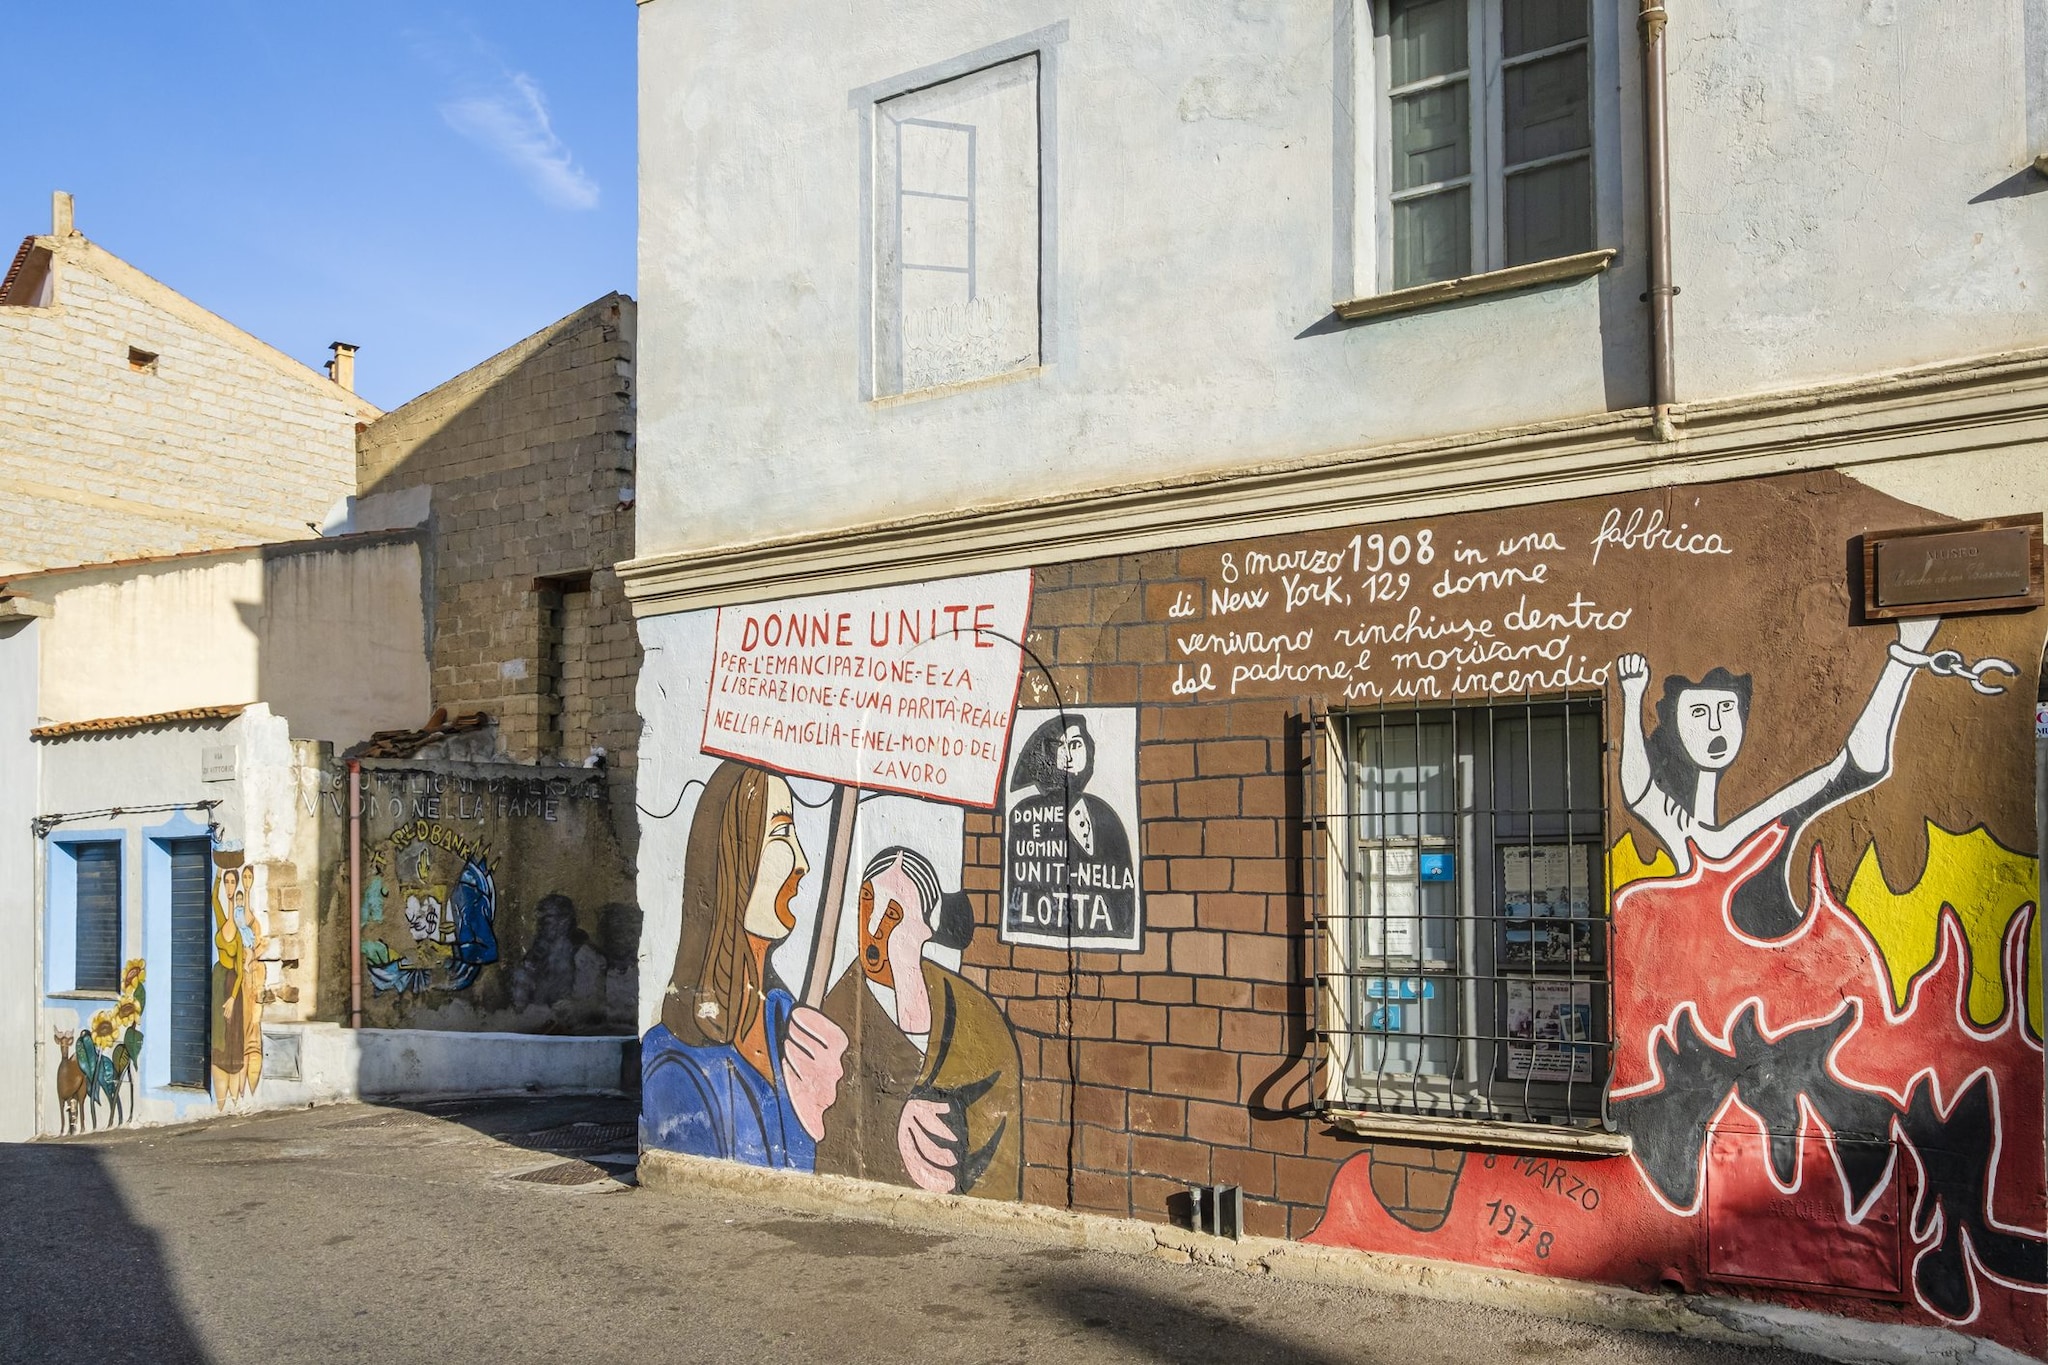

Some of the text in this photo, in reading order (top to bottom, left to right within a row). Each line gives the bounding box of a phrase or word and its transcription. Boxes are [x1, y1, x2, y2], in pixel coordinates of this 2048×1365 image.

[1220, 507, 1733, 583] 8 marzo 1908 in una fabbrica
[1168, 590, 1196, 618] di
[1211, 587, 1270, 616] New
[1361, 572, 1410, 603] 129
[1432, 562, 1549, 599] donne
[741, 604, 995, 652] DONNE UNITE
[1177, 591, 1633, 656] venivano rinchiuse dentro
[1353, 649, 1371, 671] e
[1390, 634, 1571, 671] morivano
[1342, 654, 1613, 699] in un incendio
[873, 760, 947, 785] LAVORO
[498, 799, 558, 822] FAME
[1014, 805, 1064, 824] DONNE
[1016, 840, 1068, 858] UOMINI
[1021, 891, 1114, 931] LOTTA
[1513, 1154, 1600, 1211] MARZO
[1486, 1199, 1555, 1260] 1978
[1768, 1197, 1839, 1222] ACQUA
